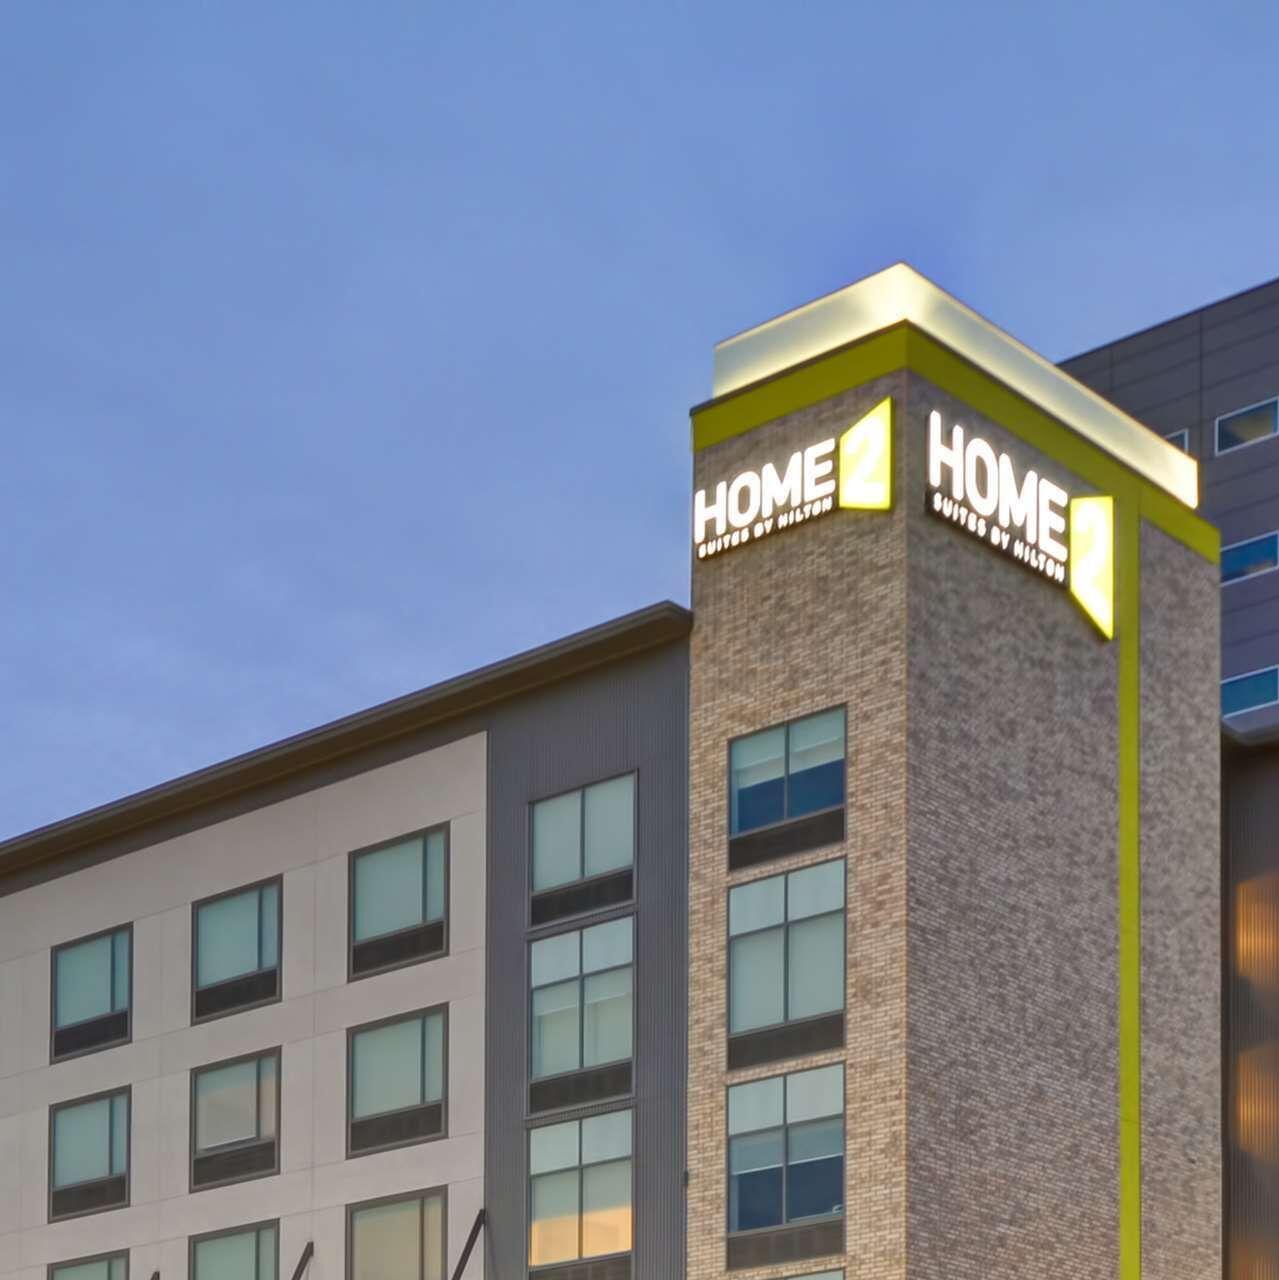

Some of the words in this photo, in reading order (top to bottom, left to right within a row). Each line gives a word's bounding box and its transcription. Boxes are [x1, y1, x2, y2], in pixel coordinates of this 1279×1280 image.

[698, 527, 750, 559] SUITES
[754, 518, 773, 538] BY
[778, 496, 833, 530] HILTON
[933, 492, 987, 537] SUITES
[990, 525, 1010, 549] BY
[1013, 539, 1065, 582] HILTON
